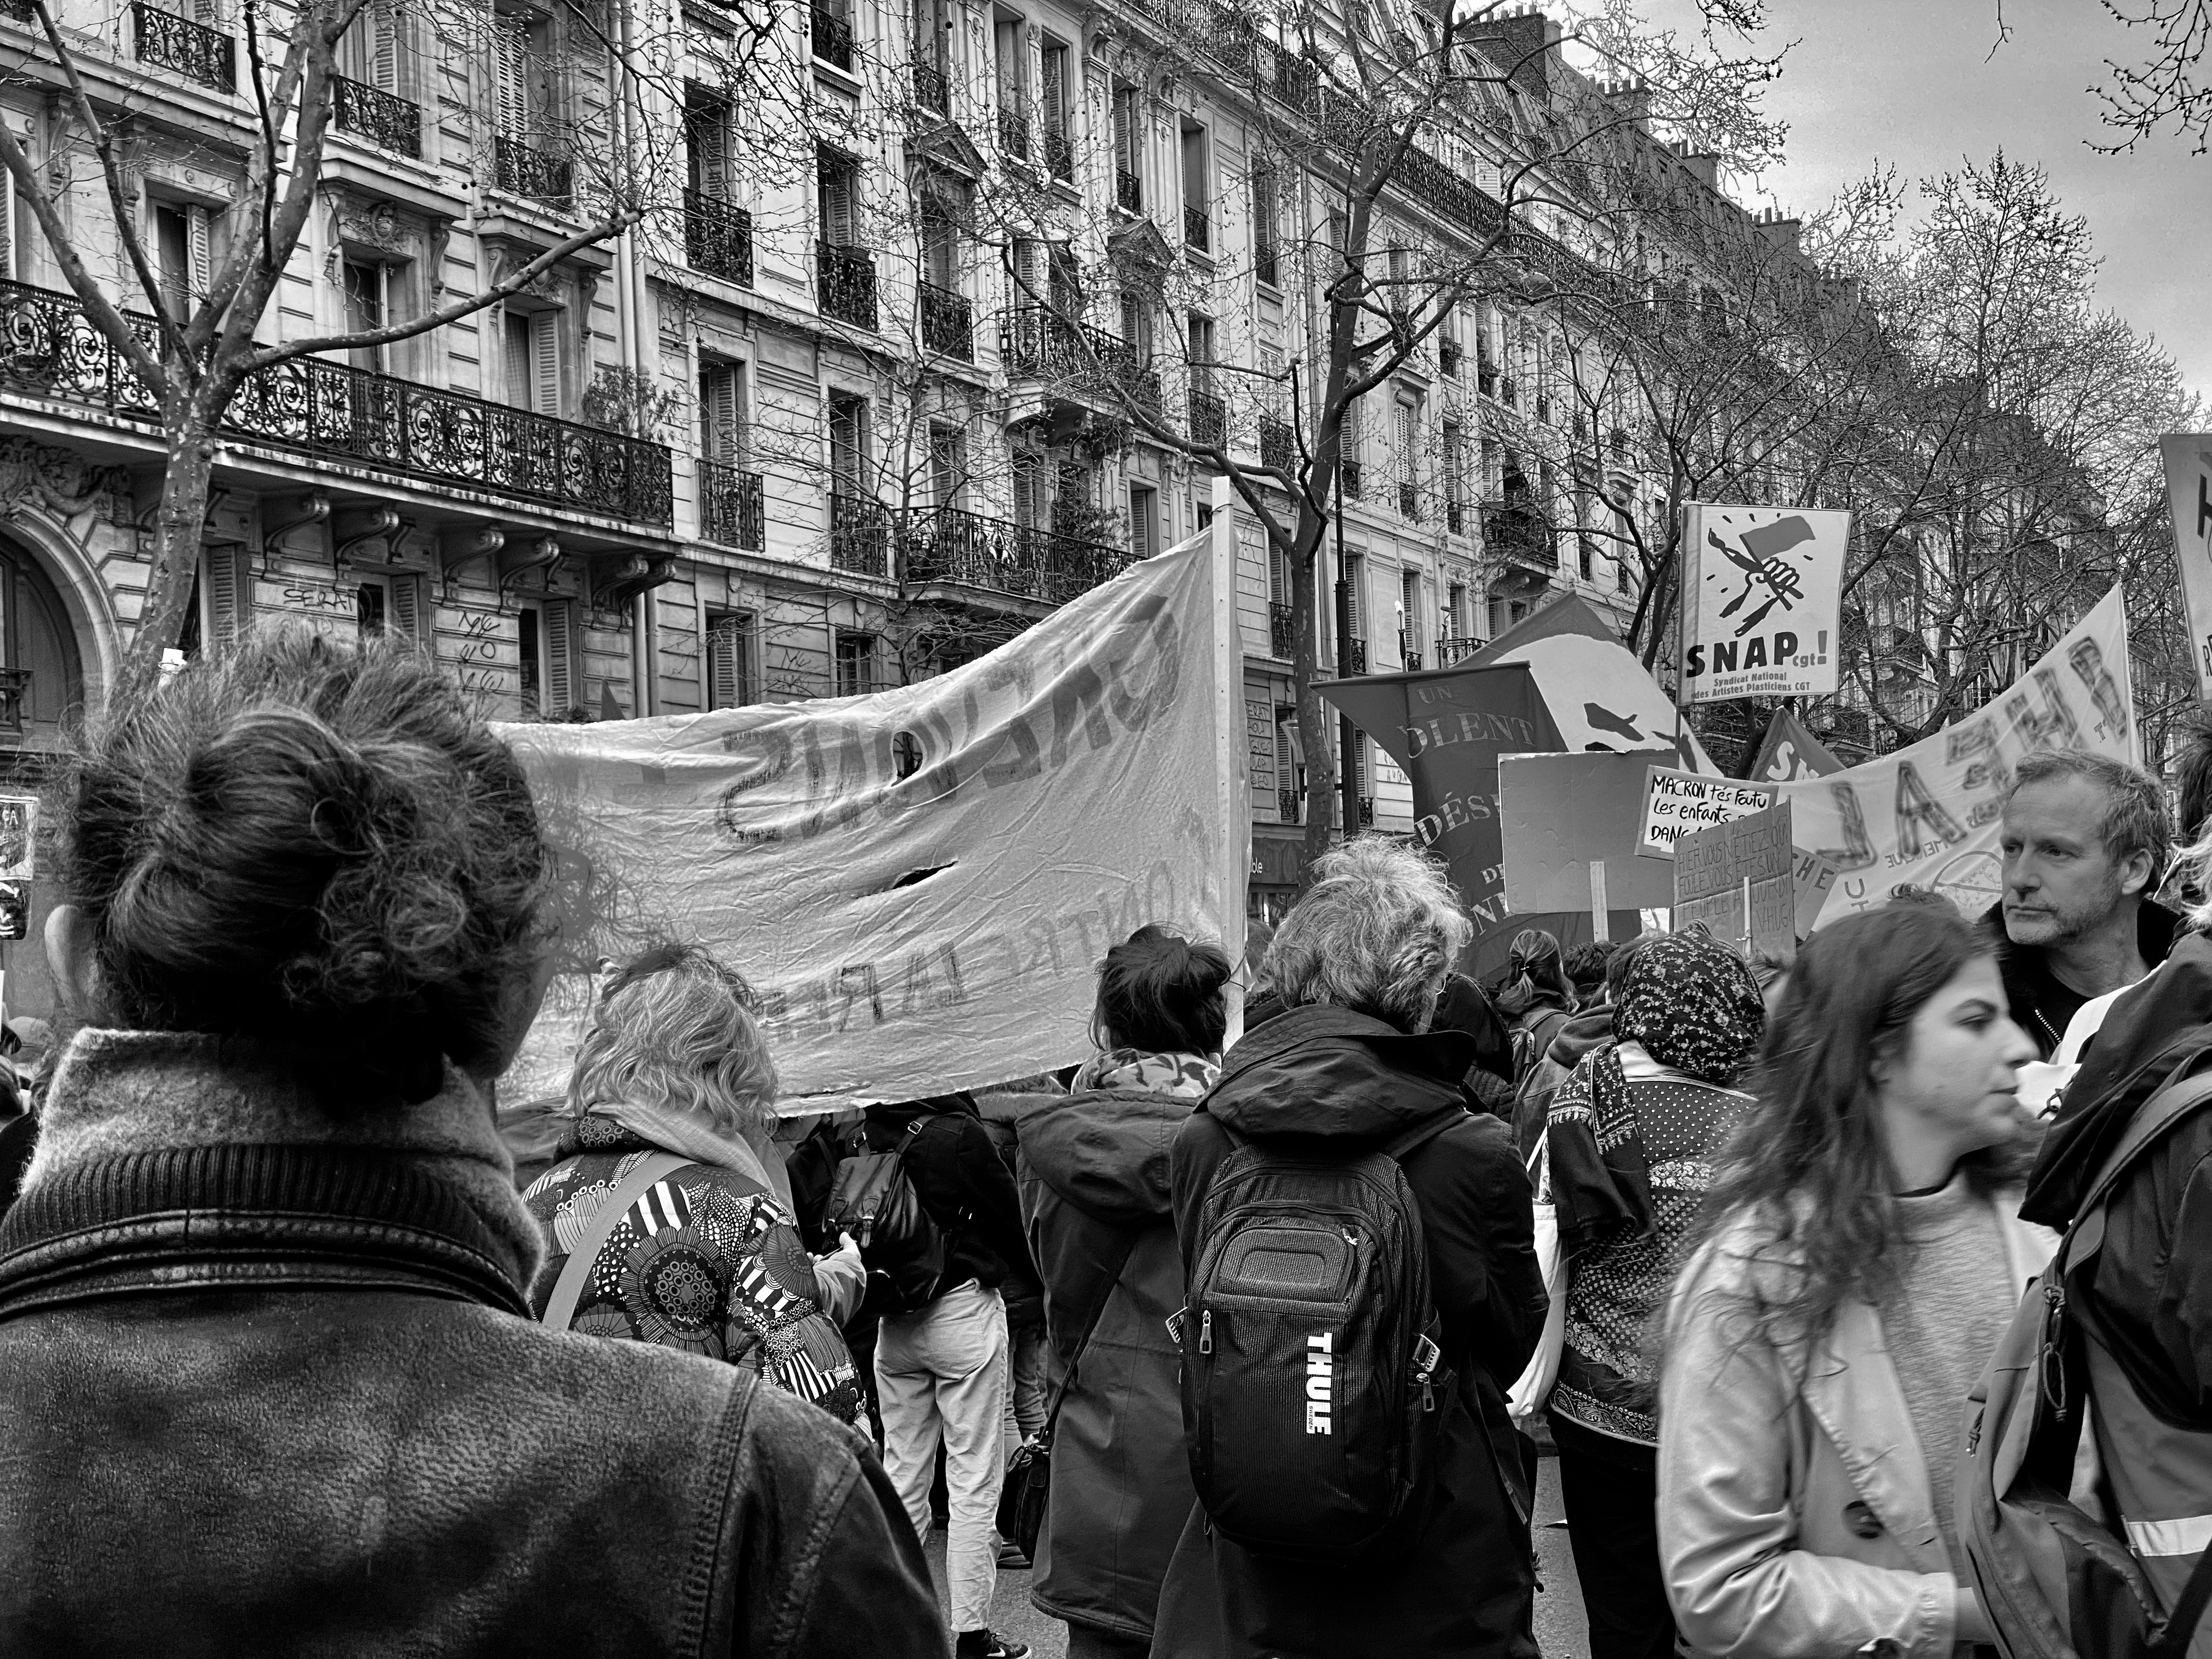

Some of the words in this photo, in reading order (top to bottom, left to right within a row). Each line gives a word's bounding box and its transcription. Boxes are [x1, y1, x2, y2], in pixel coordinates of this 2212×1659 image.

[1686, 631, 1798, 678] SNAP
[1712, 685, 1743, 697] Artistes
[1747, 682, 1792, 692] Plasticiens
[1795, 682, 1810, 691] CGT
[1714, 675, 1749, 687] Syndicat
[1751, 672, 1787, 681] National
[1416, 686, 1453, 704] UN
[1651, 774, 1707, 799] MACRON
[1679, 848, 1700, 873] HIER
[1702, 842, 1723, 866] VOUS
[1708, 865, 1733, 888] VOUS
[1306, 1332, 1332, 1435] THULE
